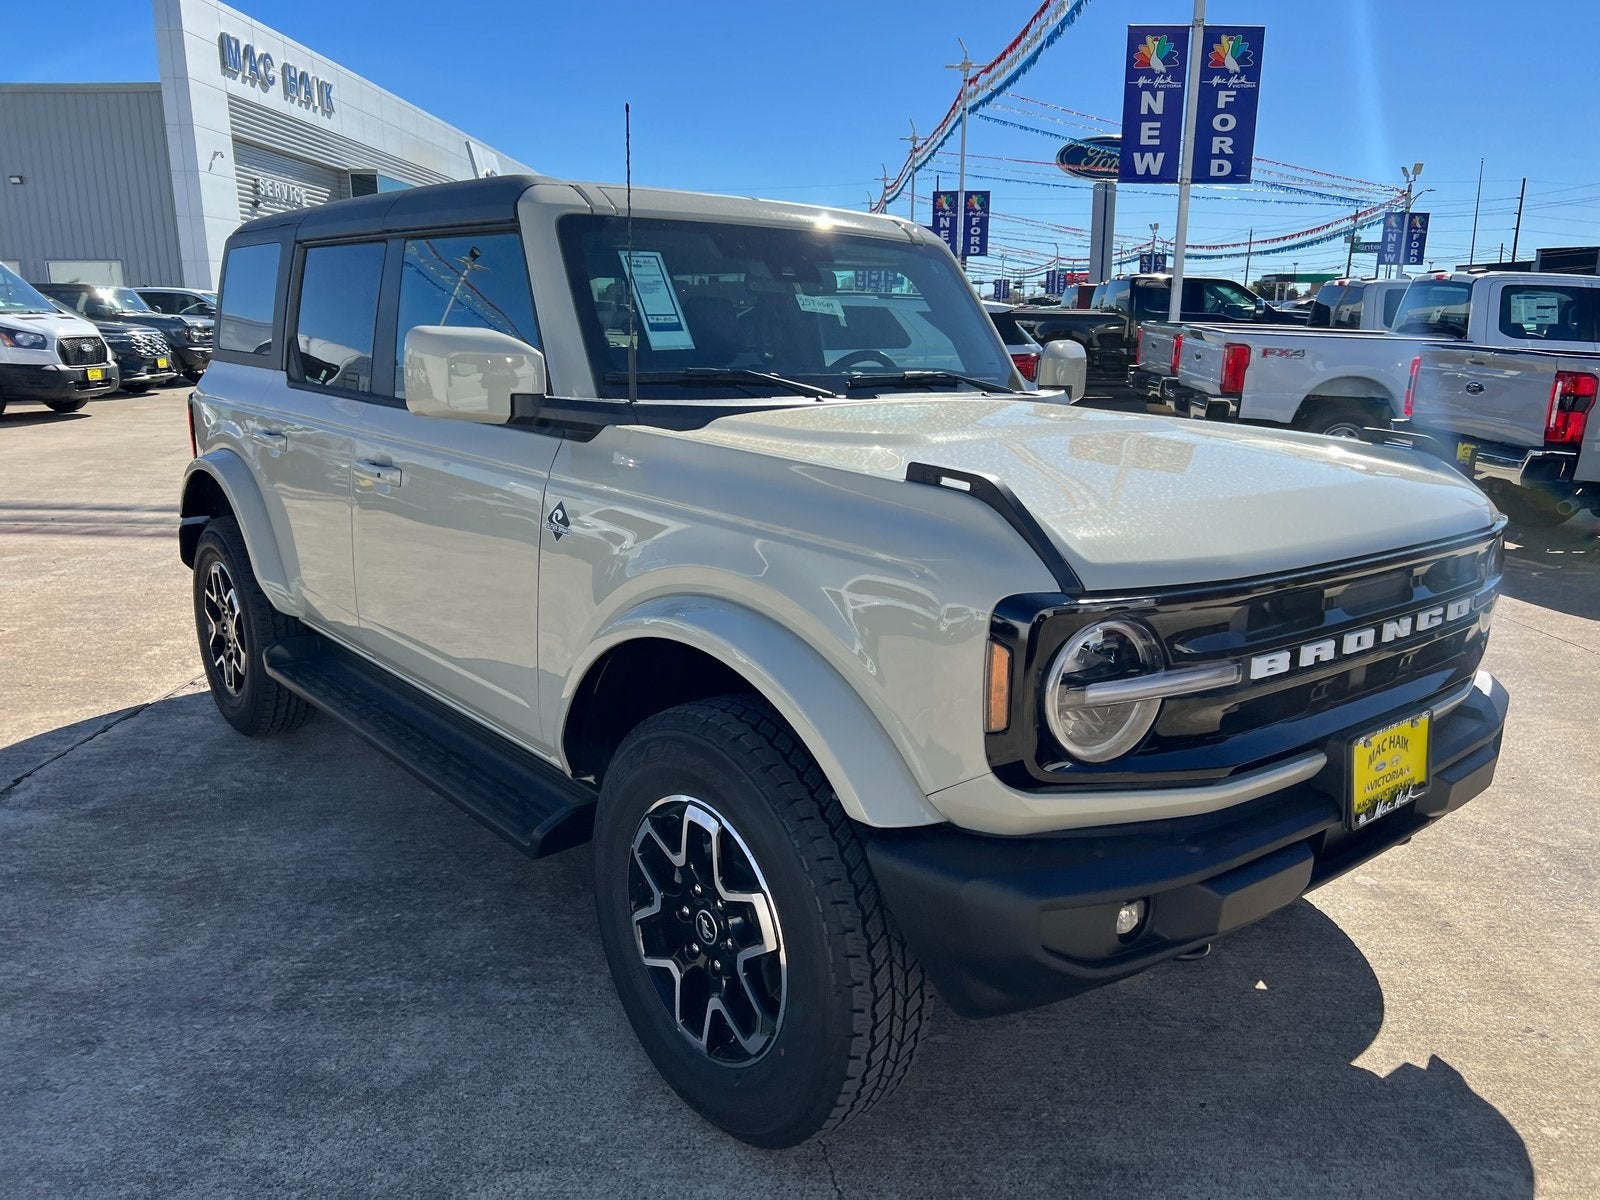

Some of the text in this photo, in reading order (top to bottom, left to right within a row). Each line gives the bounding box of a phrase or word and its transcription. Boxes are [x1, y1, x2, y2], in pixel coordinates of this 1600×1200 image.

[218, 32, 335, 116] MAC HAIK
[1133, 91, 1165, 175] NEW
[1209, 91, 1237, 177] FORD
[1081, 146, 1120, 171] For
[259, 178, 307, 204] SERVICE
[939, 217, 950, 248] NE
[969, 217, 981, 254] FORD
[1384, 233, 1397, 262] NEW
[1409, 233, 1420, 263] FORD
[1262, 347, 1306, 359] FX4
[1250, 597, 1471, 680] BRONCO
[1368, 738, 1388, 769] MAC
[1388, 735, 1409, 752] HAIK
[1369, 768, 1404, 791] VICTORIA
[1374, 799, 1394, 820] Mac
